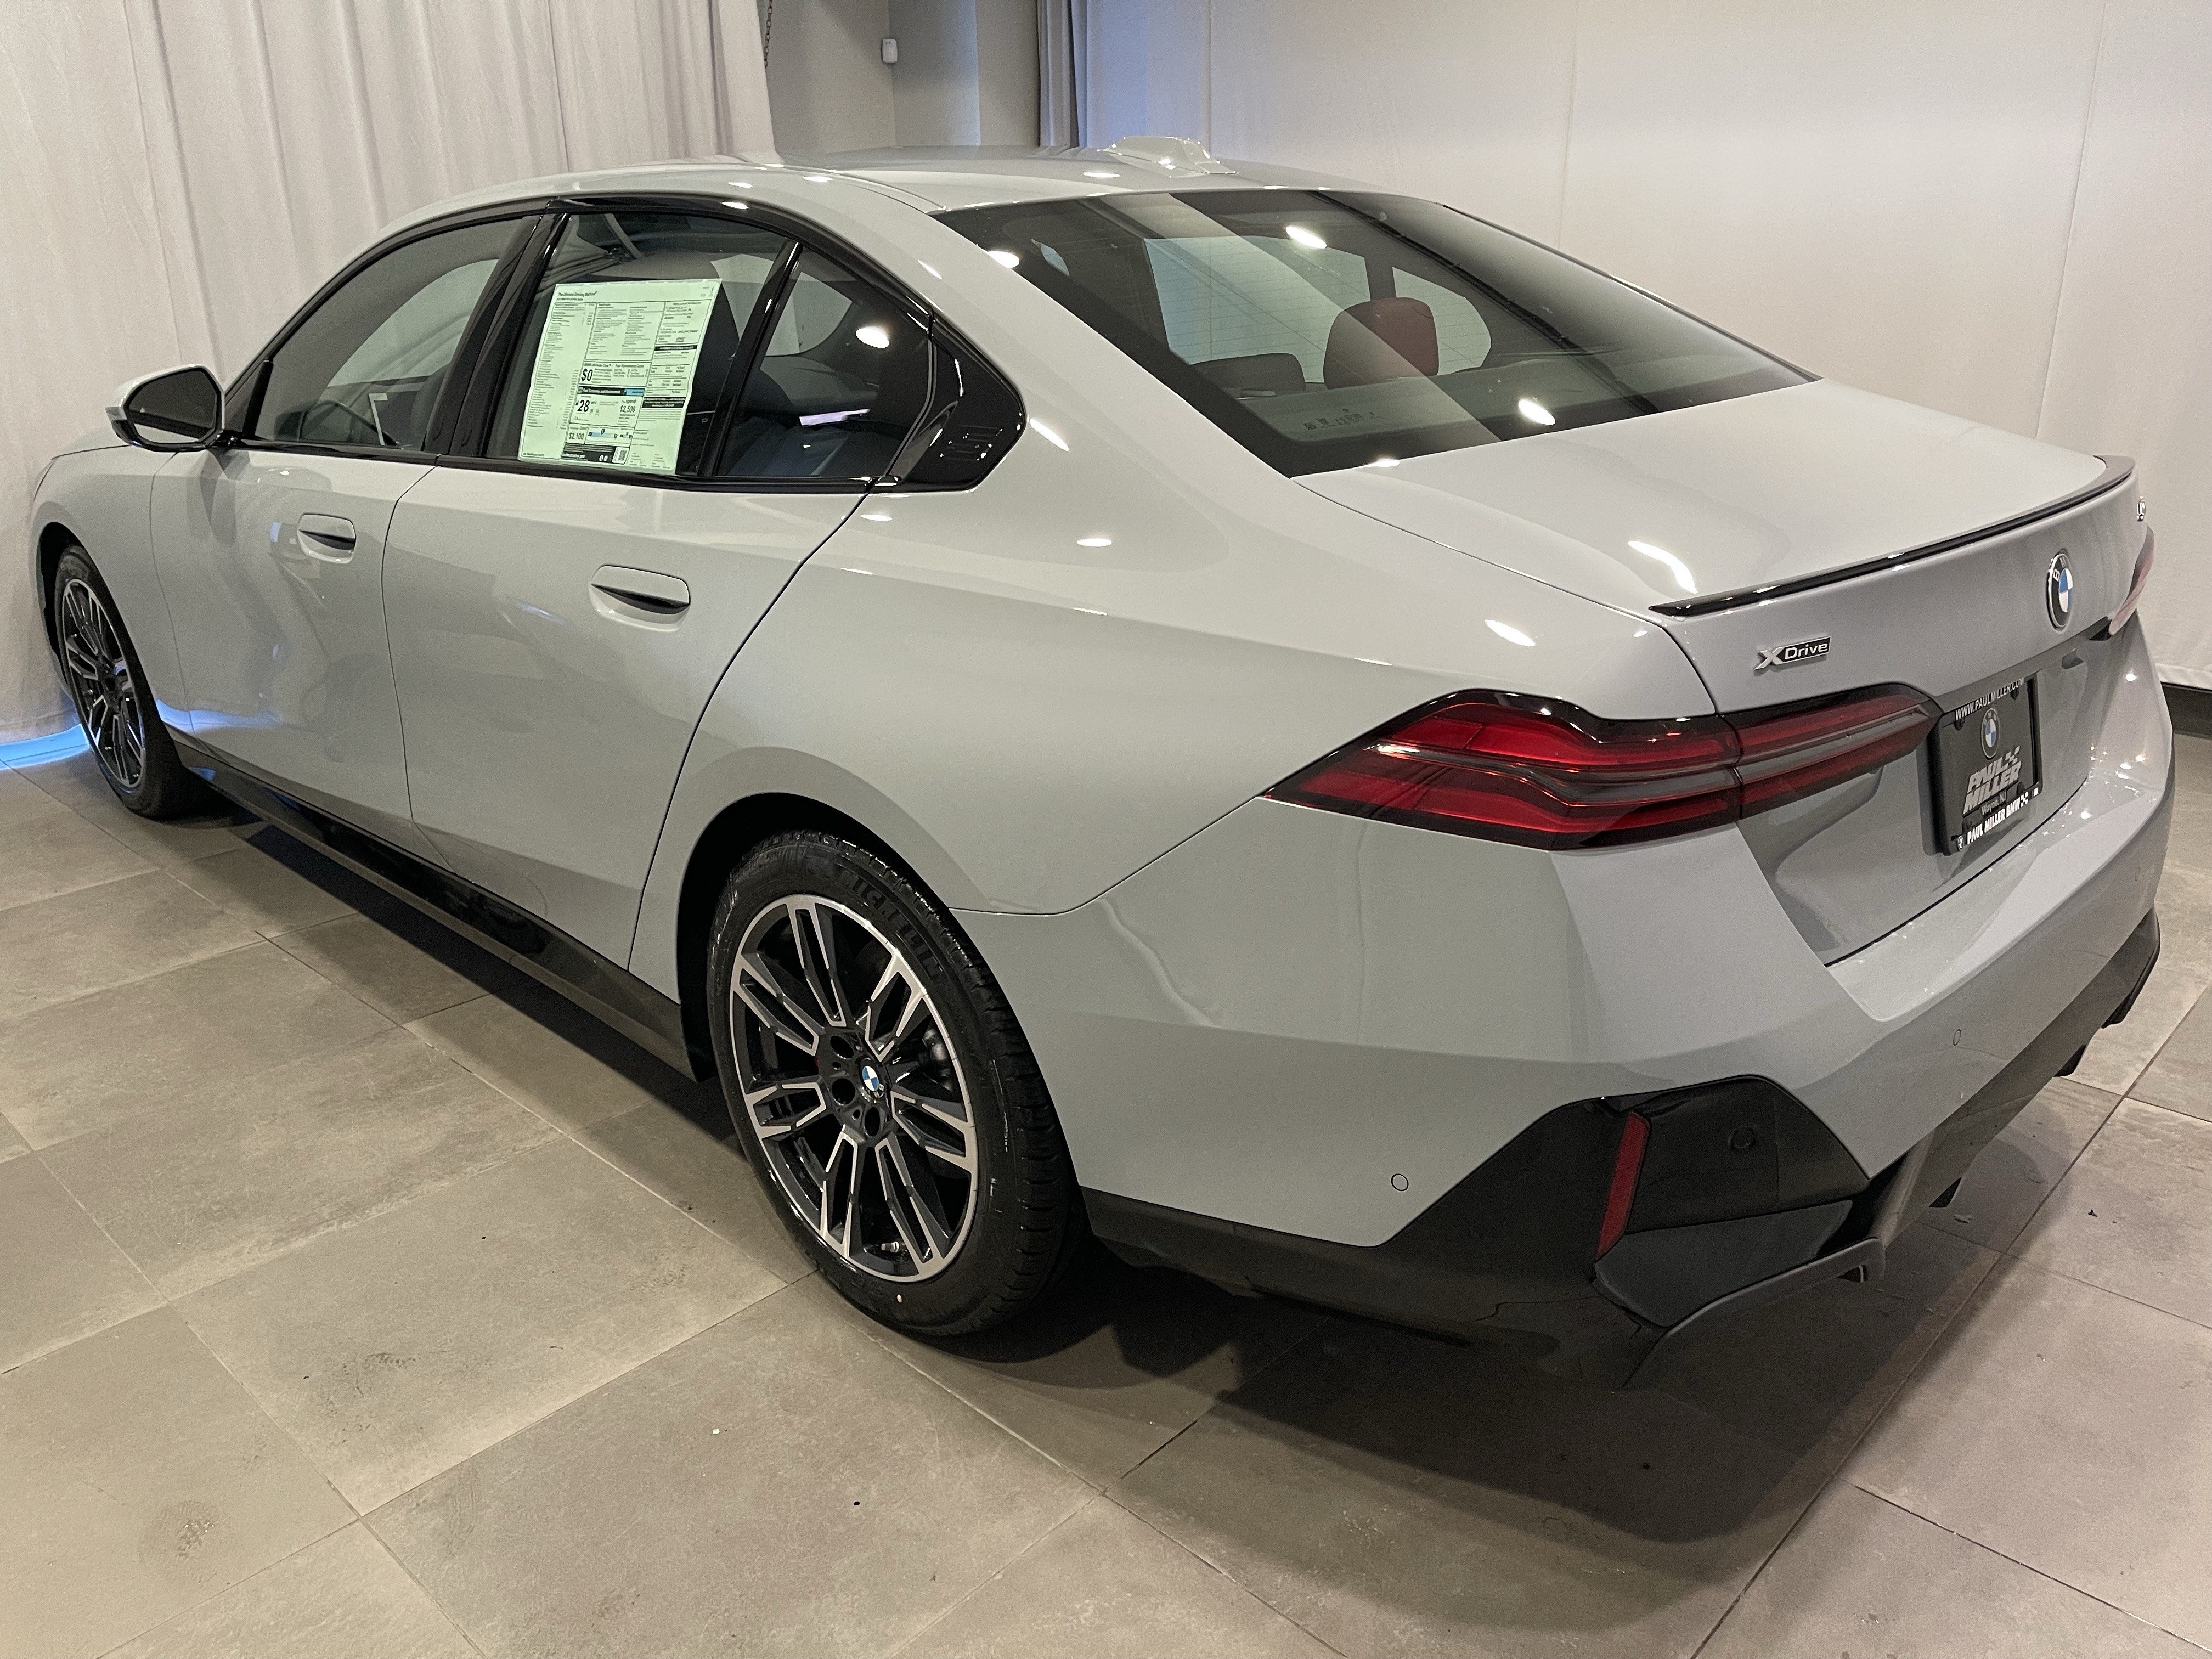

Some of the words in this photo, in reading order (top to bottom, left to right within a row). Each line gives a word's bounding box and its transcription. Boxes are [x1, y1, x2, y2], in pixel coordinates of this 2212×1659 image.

[581, 368, 593, 382] $0
[577, 400, 590, 412] 28
[620, 405, 636, 413] $2,500
[569, 432, 584, 441] $2,100
[1955, 677, 2024, 721] WWW.PAULMILLER.COM
[1963, 761, 2022, 814] MILLER
[1967, 757, 2008, 794] PAUL
[1967, 823, 1984, 845] PAUL
[1984, 808, 2005, 833] MILLER
[2006, 797, 2021, 817] BMW
[838, 868, 943, 979] MICHELIN
